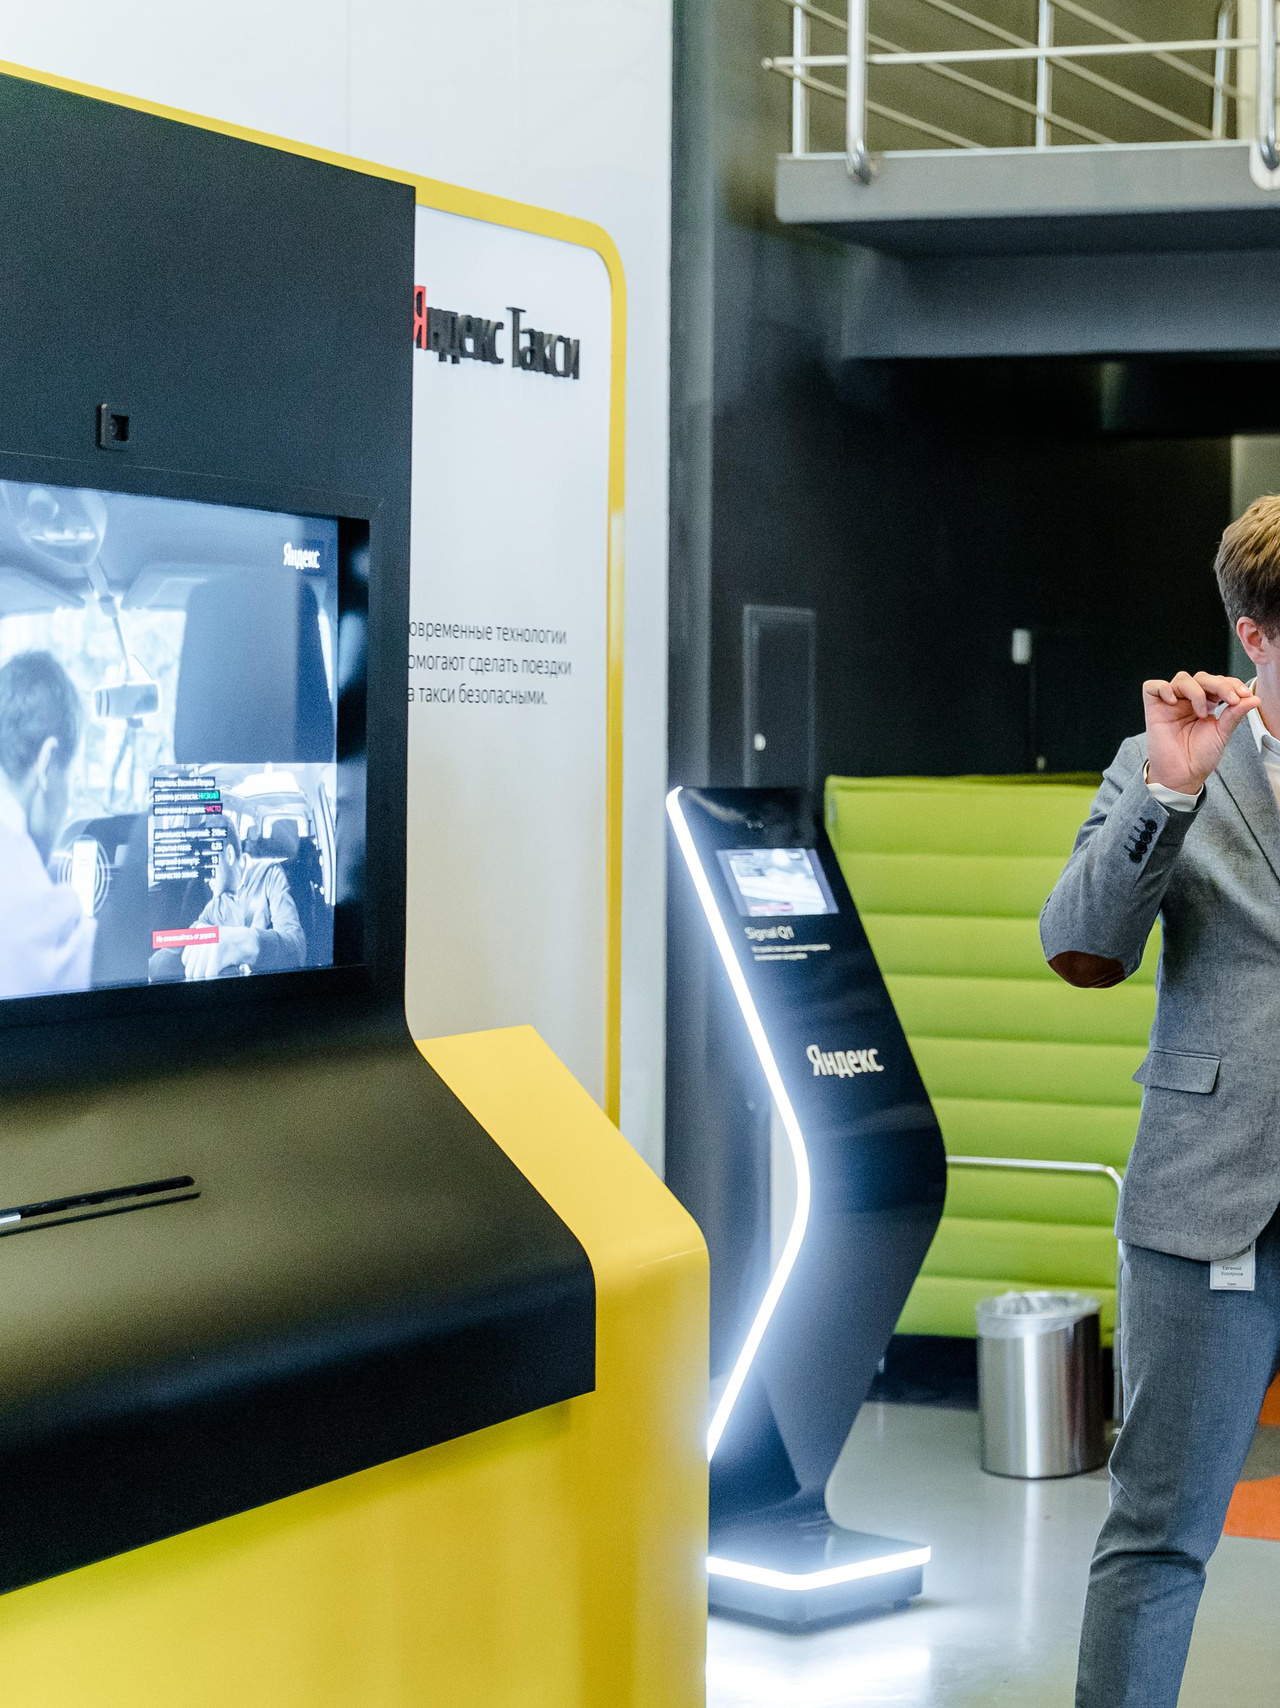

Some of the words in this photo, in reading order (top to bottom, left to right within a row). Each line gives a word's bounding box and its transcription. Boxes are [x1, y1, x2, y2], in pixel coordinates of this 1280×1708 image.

[413, 285, 504, 364] Яндекс
[506, 306, 580, 380] Такси
[283, 542, 320, 570] Яндекс
[408, 621, 493, 642] овременные
[496, 626, 567, 645] технологии
[408, 654, 466, 671] омогают
[468, 656, 519, 676] сделать
[521, 659, 572, 679] поездки
[407, 687, 415, 702] а
[419, 687, 455, 703] такси
[458, 682, 547, 705] безопасными.
[806, 1044, 884, 1078] Яндекс
